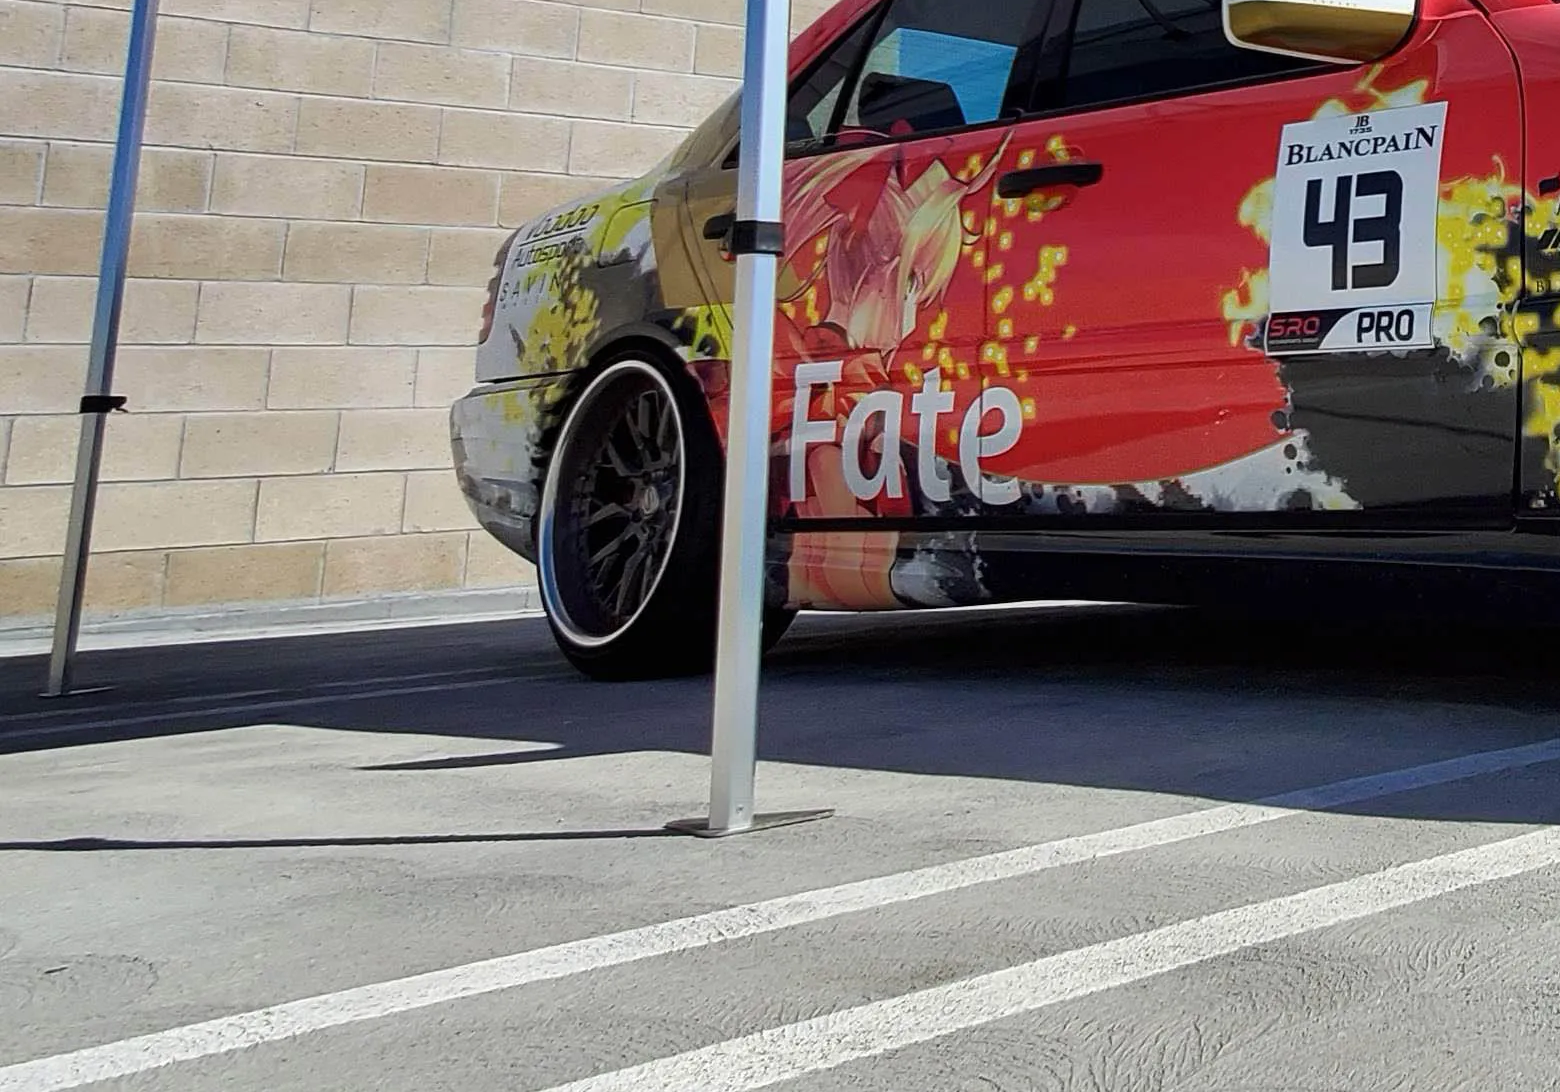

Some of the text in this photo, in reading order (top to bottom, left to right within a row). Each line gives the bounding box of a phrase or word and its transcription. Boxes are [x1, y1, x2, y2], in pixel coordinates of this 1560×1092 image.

[1285, 125, 1438, 166] BLANCPAIN
[1349, 126, 1373, 135] 1735
[1303, 170, 1403, 291] 43
[1270, 317, 1320, 337] SRO
[1357, 309, 1415, 343] PRO
[790, 360, 1022, 506] Fate
